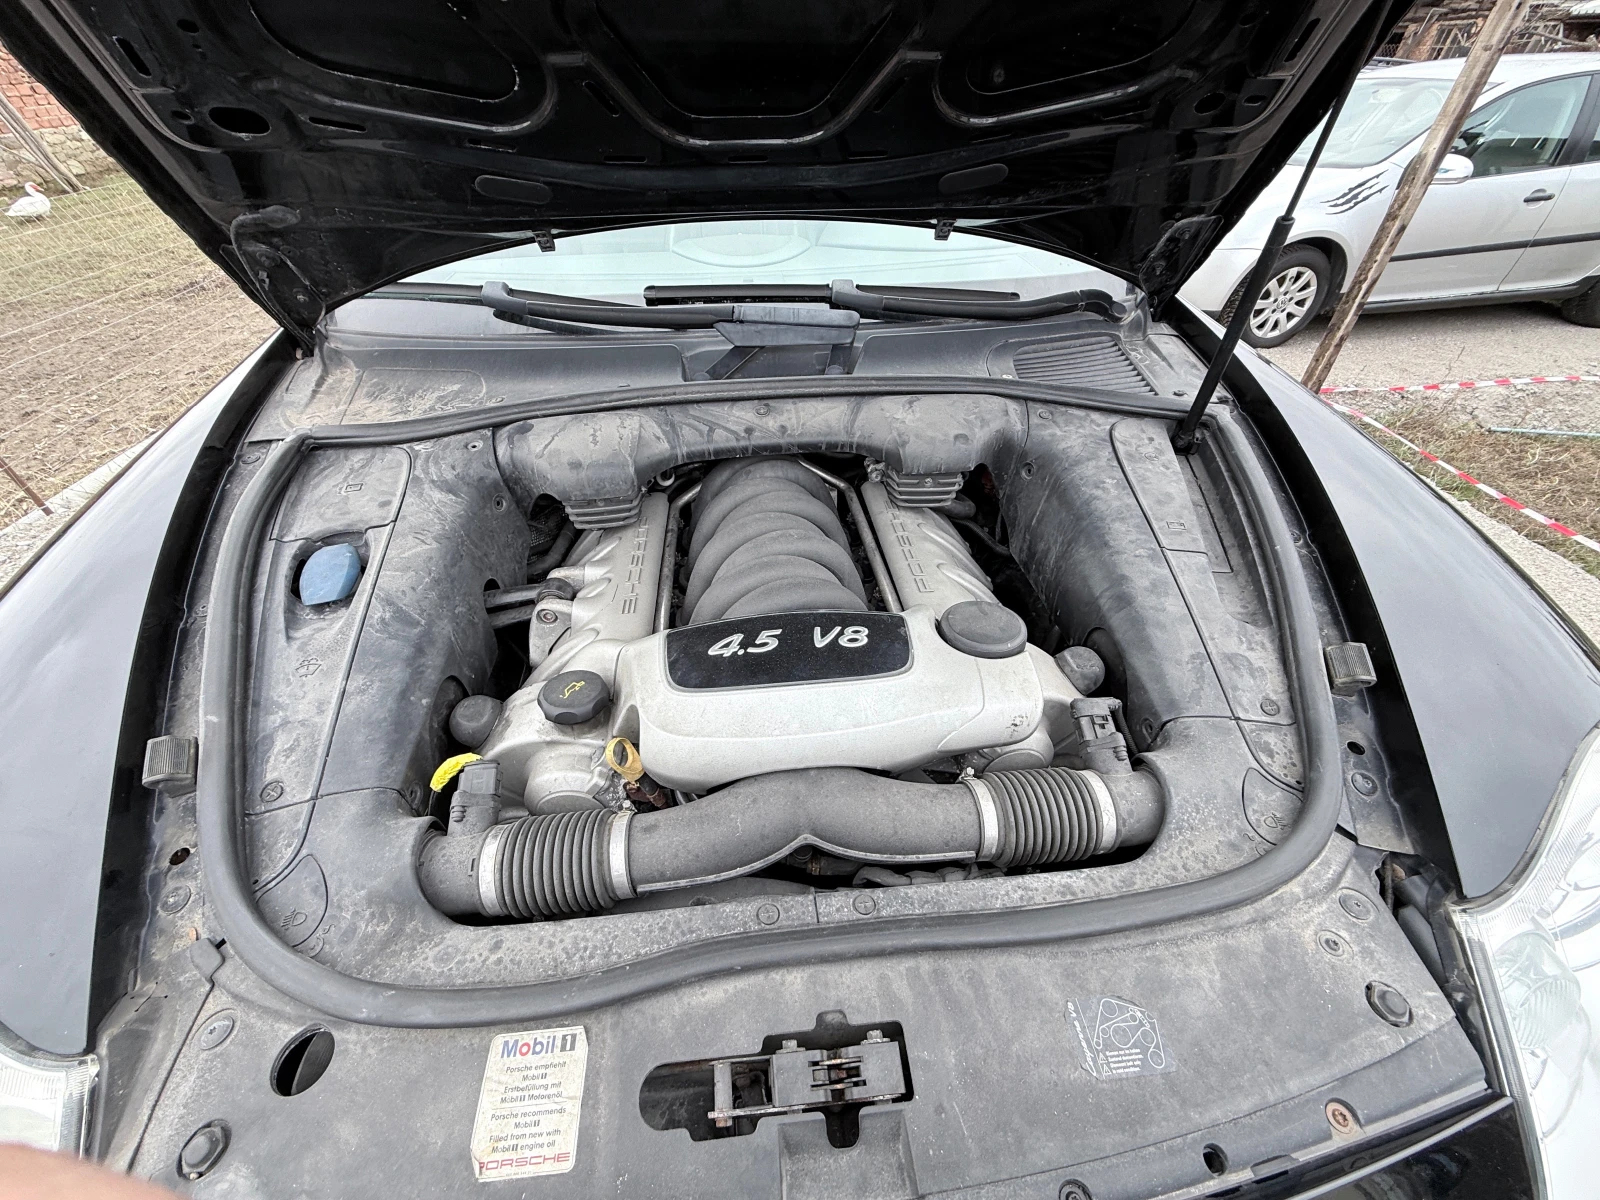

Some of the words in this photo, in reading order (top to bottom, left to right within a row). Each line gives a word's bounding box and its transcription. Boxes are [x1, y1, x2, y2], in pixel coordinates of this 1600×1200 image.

[707, 628, 783, 657] 4.5
[812, 625, 869, 648] V8
[501, 1035, 556, 1058] Mobil
[562, 1033, 576, 1051] 1
[505, 1064, 533, 1073] Porsche
[534, 1061, 567, 1071] empfiehlt
[521, 1073, 541, 1082] Mobil
[503, 1083, 549, 1094] Erstbefüllung
[550, 1081, 562, 1089] mit
[499, 1096, 519, 1105] Mobil
[527, 1090, 563, 1101] Motorenöl
[490, 1111, 519, 1122] Porsche
[520, 1107, 567, 1119] recommends
[513, 1121, 533, 1130] Mobil
[488, 1133, 509, 1143] Filled
[509, 1132, 527, 1141] from
[528, 1130, 545, 1139] new
[545, 1128, 562, 1137] with
[490, 1144, 512, 1154] Mobil
[519, 1141, 545, 1152] engine
[546, 1139, 556, 1148] oil
[479, 1152, 570, 1175] PORSCHE
